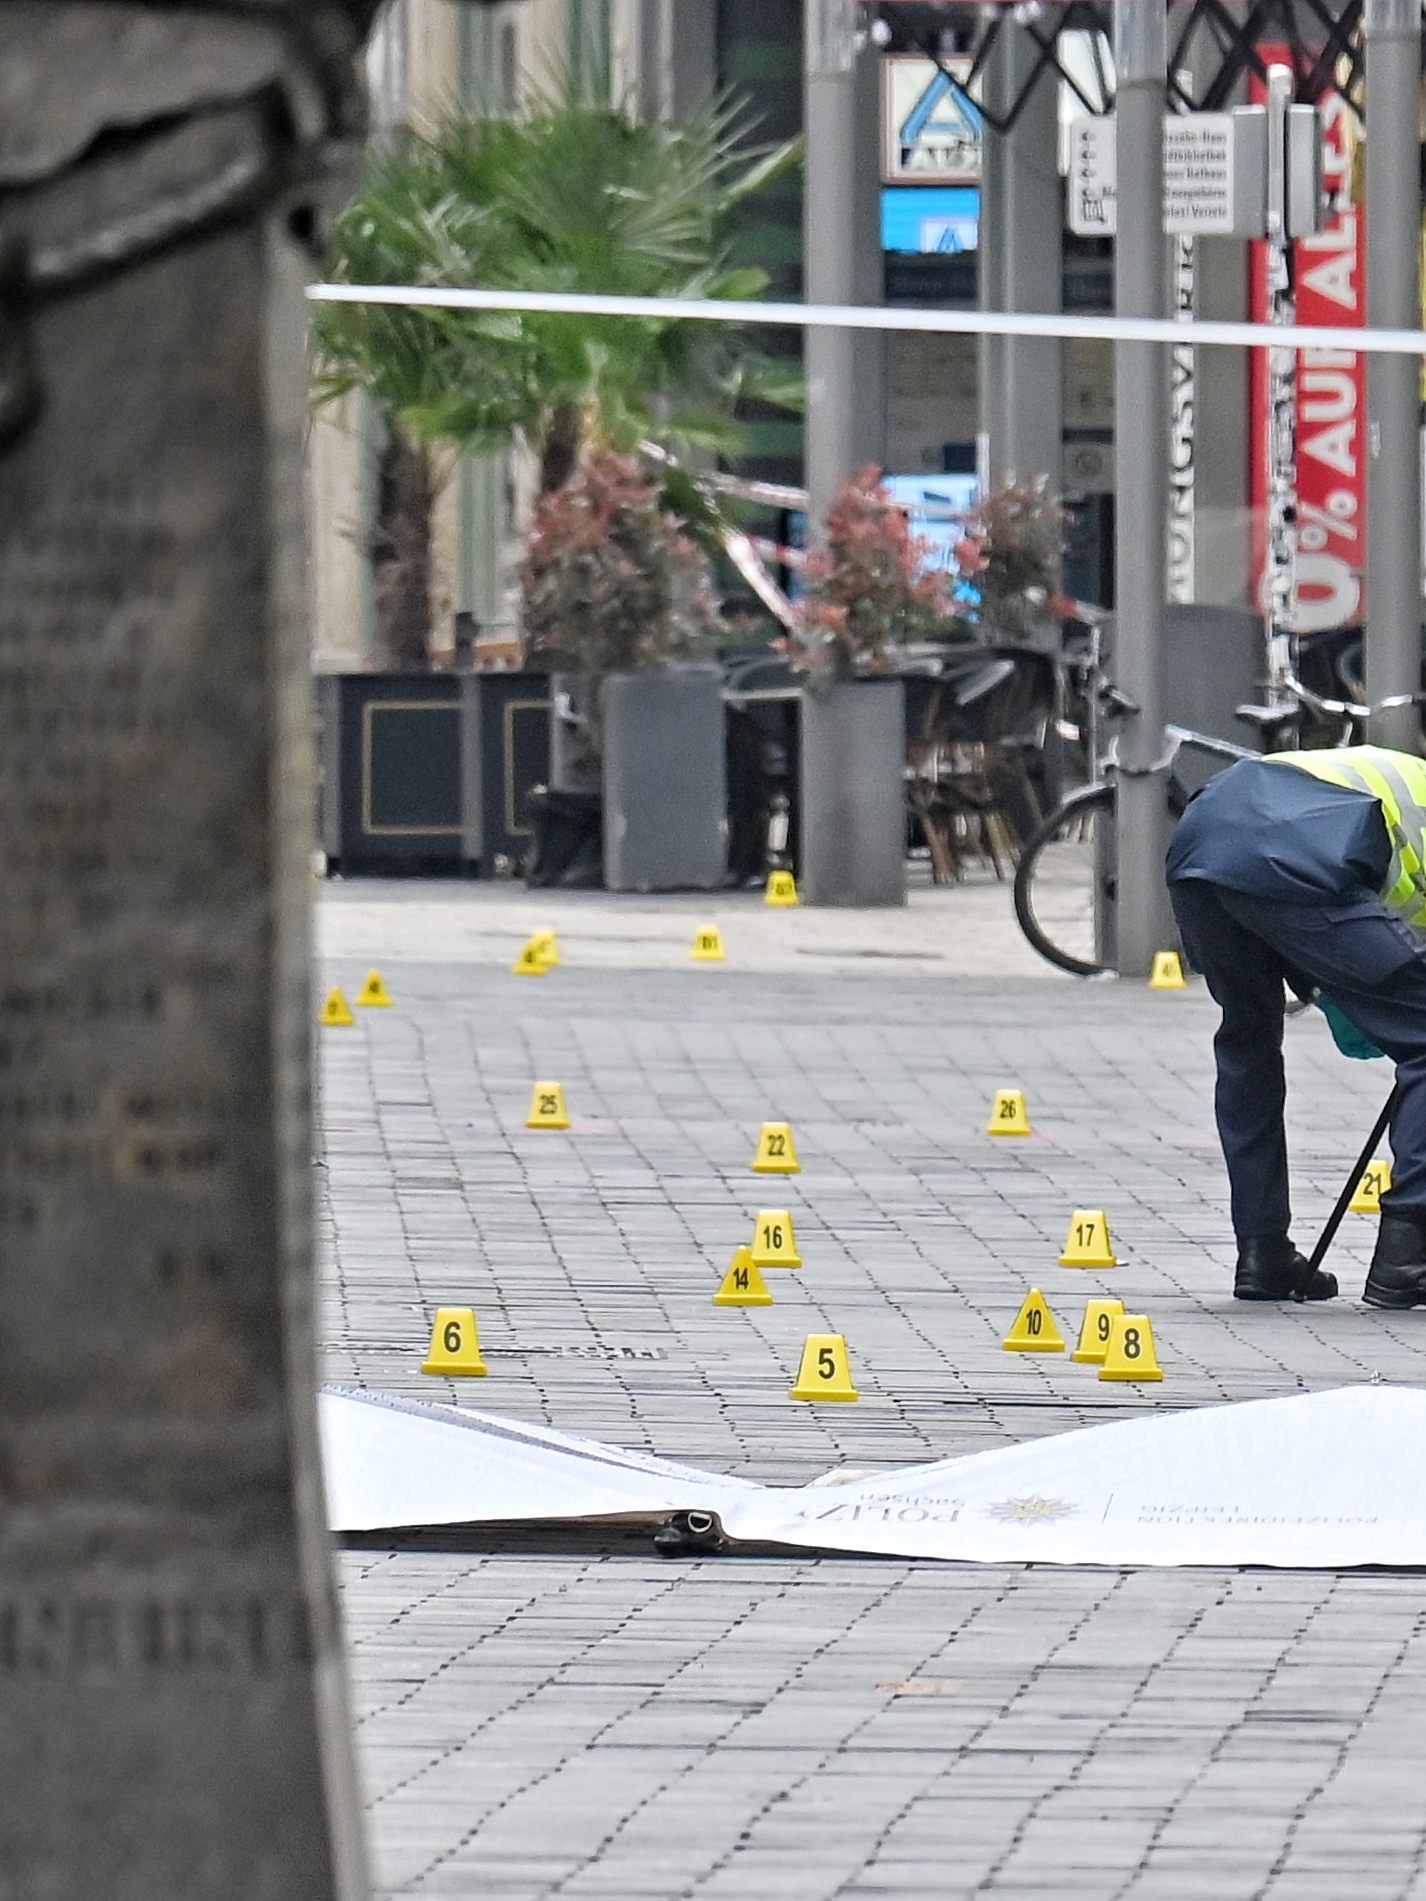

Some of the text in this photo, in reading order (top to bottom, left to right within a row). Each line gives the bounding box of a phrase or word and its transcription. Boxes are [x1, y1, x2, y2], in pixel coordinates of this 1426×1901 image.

[539, 1095, 558, 1114] 25
[999, 1099, 1017, 1119] 26
[767, 1134, 786, 1156] 22
[1362, 1172, 1382, 1196] 21
[763, 1224, 783, 1249] 16
[1076, 1223, 1096, 1247] 17
[733, 1267, 750, 1290] 14
[1025, 1308, 1042, 1336] 10
[1098, 1313, 1111, 1342] 9
[443, 1321, 462, 1353] 6
[1124, 1328, 1141, 1359] 8
[818, 1347, 835, 1379] 5
